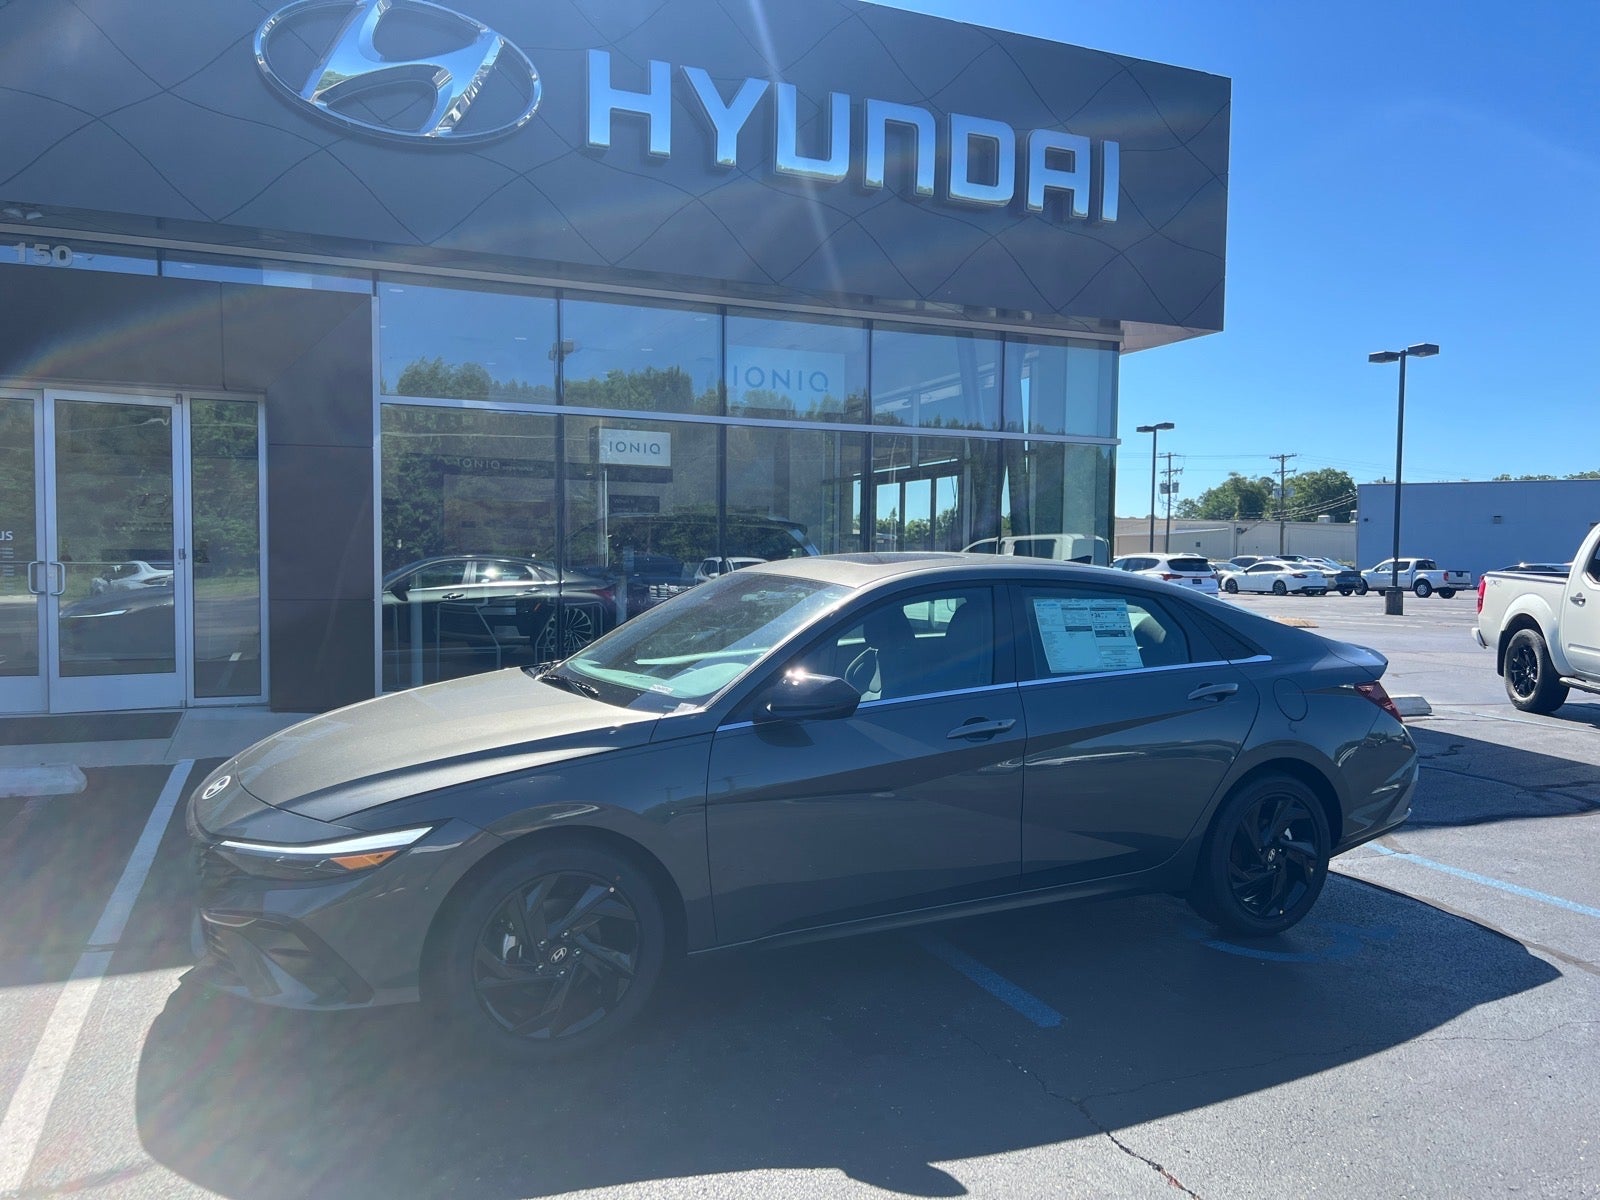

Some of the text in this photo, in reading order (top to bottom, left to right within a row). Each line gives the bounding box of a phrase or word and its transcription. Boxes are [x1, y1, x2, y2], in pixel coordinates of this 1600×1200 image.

[586, 49, 1120, 222] HYUNDAI
[14, 242, 73, 267] 150
[733, 365, 828, 392] IONIQ
[609, 441, 660, 454] IONIQ
